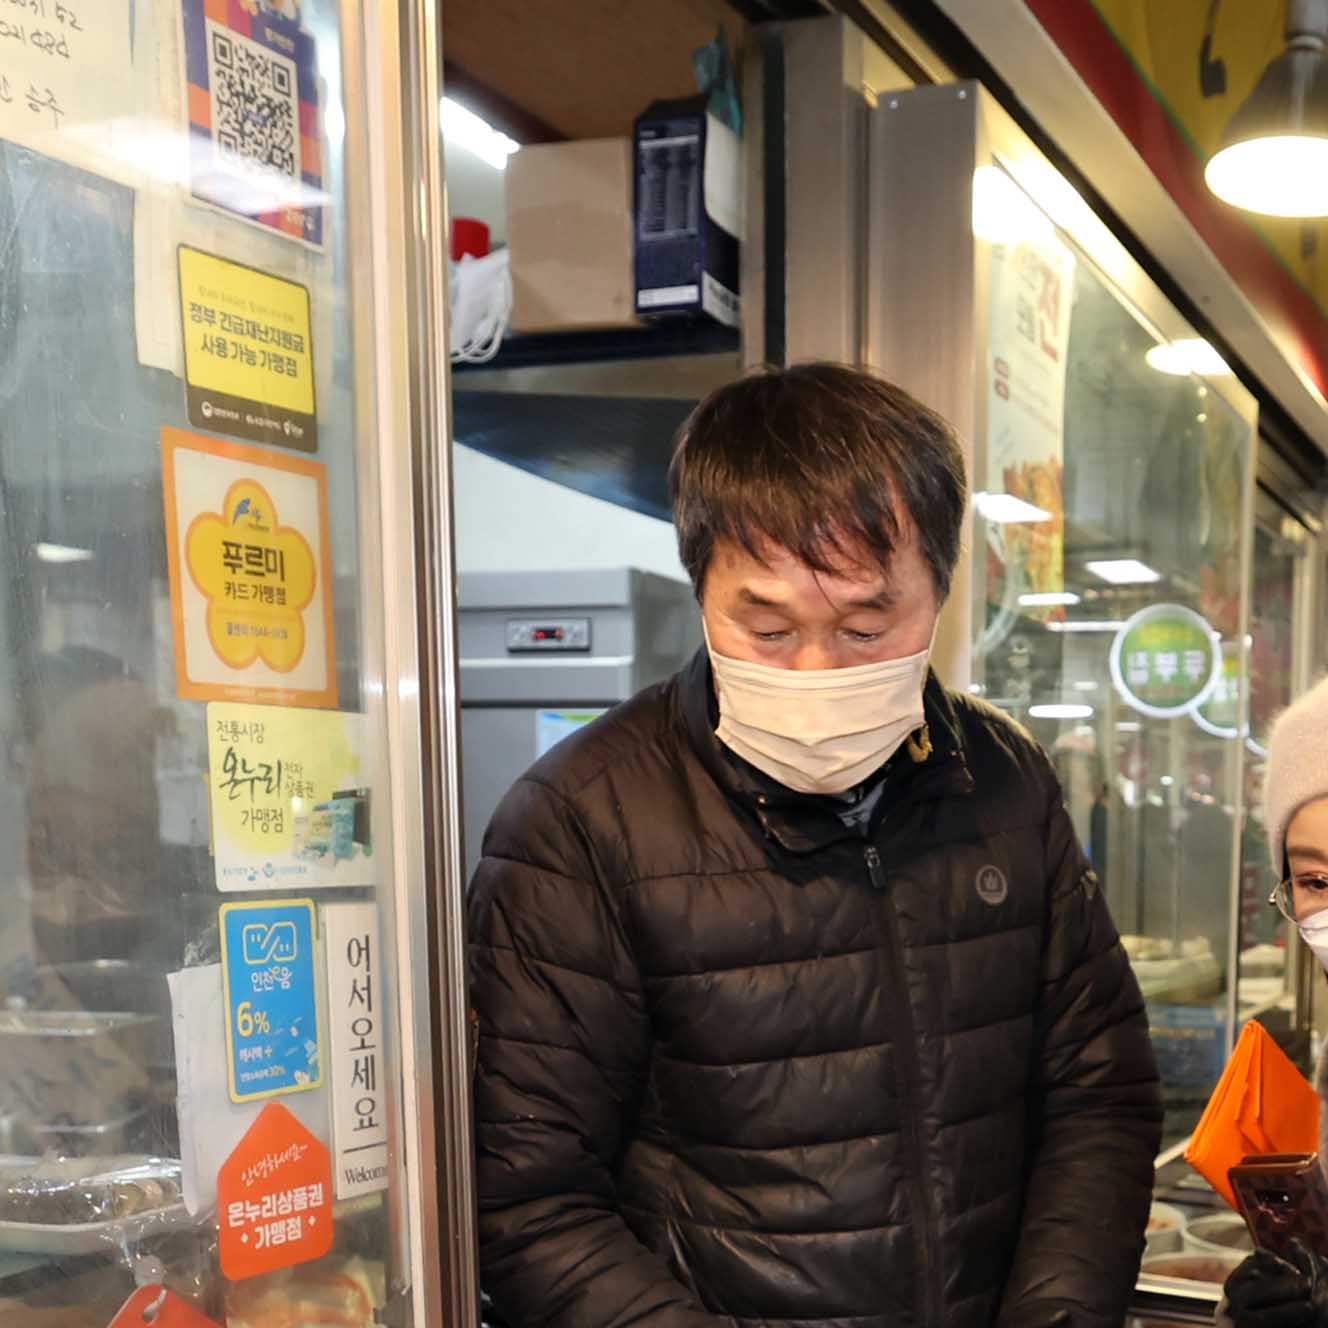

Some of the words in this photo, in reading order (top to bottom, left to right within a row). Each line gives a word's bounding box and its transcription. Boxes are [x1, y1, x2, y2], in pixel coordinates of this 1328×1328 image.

[189, 301, 217, 328] 정부
[219, 311, 306, 355] 긴급재난지원금
[200, 333, 228, 359] 사용
[230, 341, 257, 367] 가능
[260, 350, 298, 378] 가맹점
[222, 540, 285, 582] 푸르미
[224, 581, 250, 600] 카드
[251, 584, 287, 606] 가맹점
[216, 719, 265, 744] 전통시장
[219, 746, 282, 801] 온누리
[240, 808, 284, 833] 가맹점
[237, 1001, 271, 1037] 6%
[347, 934, 379, 1132] 어서오세요
[344, 1163, 387, 1185] Welcom
[227, 1183, 324, 1228] 온누리상품권
[254, 1217, 302, 1249] 가맹점
